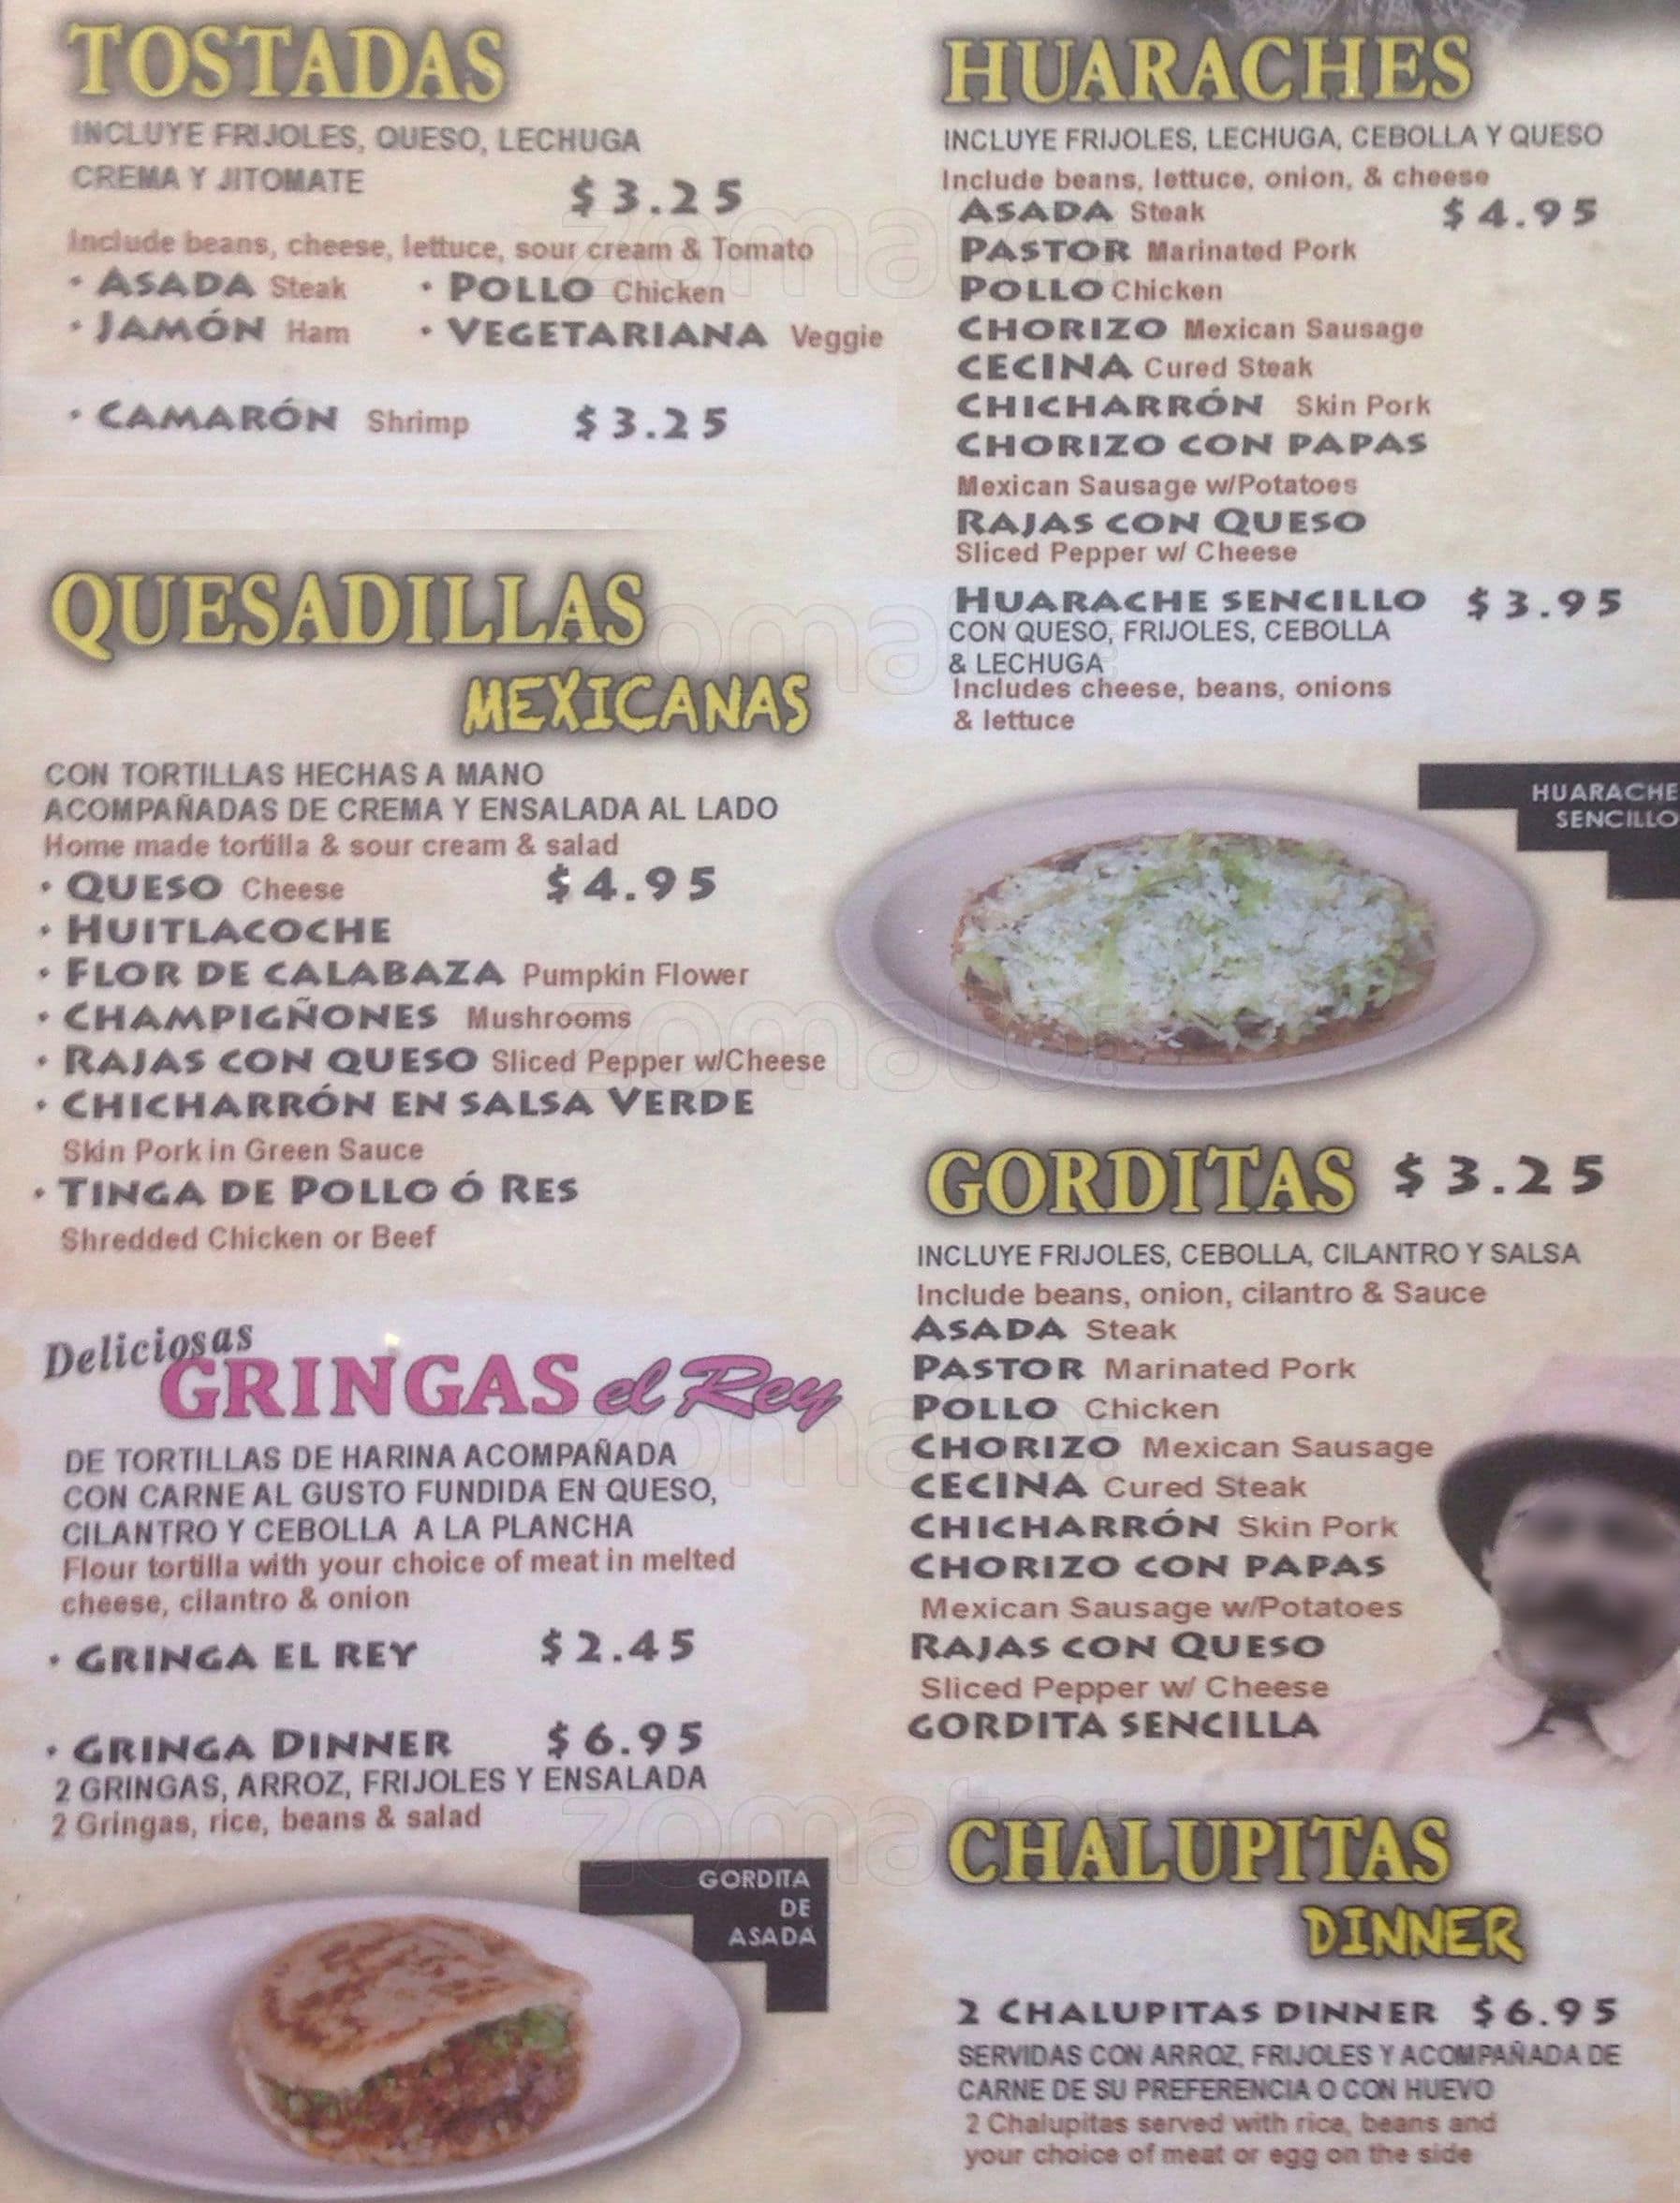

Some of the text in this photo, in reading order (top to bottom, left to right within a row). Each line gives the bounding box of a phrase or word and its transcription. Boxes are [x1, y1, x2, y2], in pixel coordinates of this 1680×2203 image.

[70, 22, 506, 101] TOSTADAS
[944, 37, 1472, 102] HUARACHES
[73, 121, 203, 147] INCLUYE
[214, 123, 364, 150] FRIJOLES,
[498, 127, 641, 153] LECHUGA
[945, 124, 1603, 151] INCLUYE FRIJOLES, LECHUGA, CEBOLLA Y QUESO
[959, 199, 1204, 224] ASADA Steak
[961, 236, 1356, 262] PASTOR Marinated Pork
[96, 268, 346, 300] ASADA Steak
[449, 272, 724, 304] POLLO Chicken
[96, 309, 348, 344] JAMÓN Ham
[447, 318, 882, 354] VEGETARIANA Veggie
[958, 317, 1422, 345] CHORIZO Mexican Sausage
[957, 388, 1430, 418] CHICHARRÓN Skin Pork
[96, 399, 468, 439] CAMARÓN Shrimp
[958, 508, 1366, 538] RAJAS CON QUESO
[52, 571, 645, 659] QUESADILLAS
[956, 586, 1426, 614] HUARACHE SENCILLO
[950, 619, 1390, 644] CON QUESO, FRIJOLES, CEBOLLA
[949, 653, 1103, 674] & LECHUGA
[463, 669, 809, 735] MEXICANAS
[954, 677, 1391, 700] Includes cheese, beans, onions
[45, 794, 778, 821] ACOMPAÑADAS DE CREMA Y ENSALADA AL LADO
[1532, 783, 1679, 802] HUARACHE
[1556, 810, 1679, 828] SENCILLO
[67, 871, 343, 903] QUESO Cheese
[67, 914, 390, 944] HUITLACOCHE
[66, 957, 748, 992] FLOR DE CALABAZA Pumpkin Flower
[64, 997, 630, 1031] CHAMPIGÑONES Mushrooms
[66, 1044, 825, 1078] RAJAS CON QUESO Sliced Pepper w/Cheese
[63, 1084, 753, 1118] CHICHARRÓN EN SALSA VERDE
[927, 1145, 1355, 1215] GORDITAS
[919, 1243, 1581, 1266] INCLUYE FRIJOLES, CEBOLLA, CILANTRO Y SALSA
[45, 1323, 254, 1380] Deliciosas
[161, 1353, 843, 1430] GRINGAS el Rey
[913, 1394, 1218, 1421] POLLO Chicken
[64, 1477, 715, 1511] CON CARNE AL GUSTO FUNDIDA EN QUESO,
[911, 1471, 1305, 1499] CECINA Cured Steak
[62, 1586, 409, 1617] cheese, cilantro & onion
[921, 1596, 1403, 1624] Mexican Sausage w/Potatoes
[76, 1641, 417, 1674] GRINGA EL REY
[908, 1711, 1319, 1739] GORDITA SENCILLA
[73, 1729, 450, 1765] GRINGA DINNER
[56, 1766, 706, 1804] 2 GRINGAS, ARROZ, FRIJOLES Y ENSALADA
[949, 1818, 1451, 1883] CHALUPITAS
[699, 1870, 809, 1889] GORDITA
[780, 1899, 810, 1916] DE
[729, 1926, 817, 1945] ASADA
[1302, 1905, 1525, 1963] DINNER
[958, 1998, 1436, 2025] 2 CHALUPITAS DINNER
[958, 2041, 1621, 2067] SERVIDAS CON ARROZ, FRIJOLES Y ACOMPAÑADA DE
